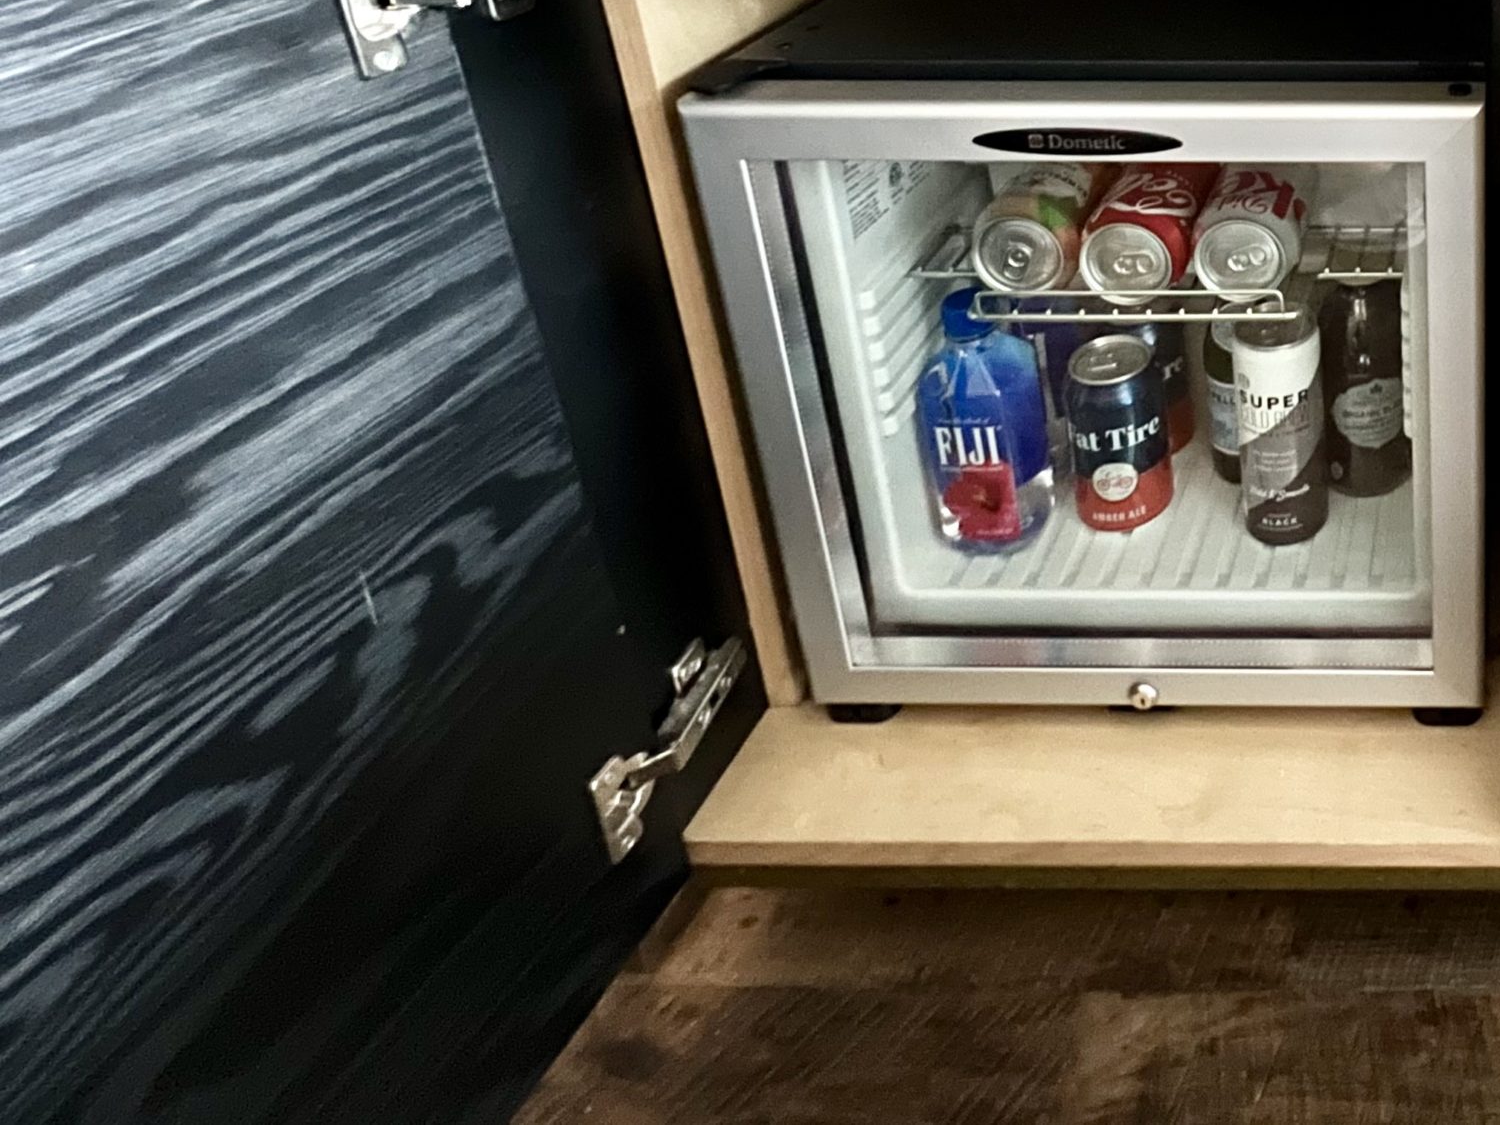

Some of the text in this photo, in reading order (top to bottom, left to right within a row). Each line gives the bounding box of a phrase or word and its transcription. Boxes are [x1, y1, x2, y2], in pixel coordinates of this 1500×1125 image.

[1048, 134, 1126, 150] Dometic
[1240, 389, 1308, 410] SUPER
[934, 426, 1001, 466] FIJI
[1074, 416, 1160, 452] at Tire
